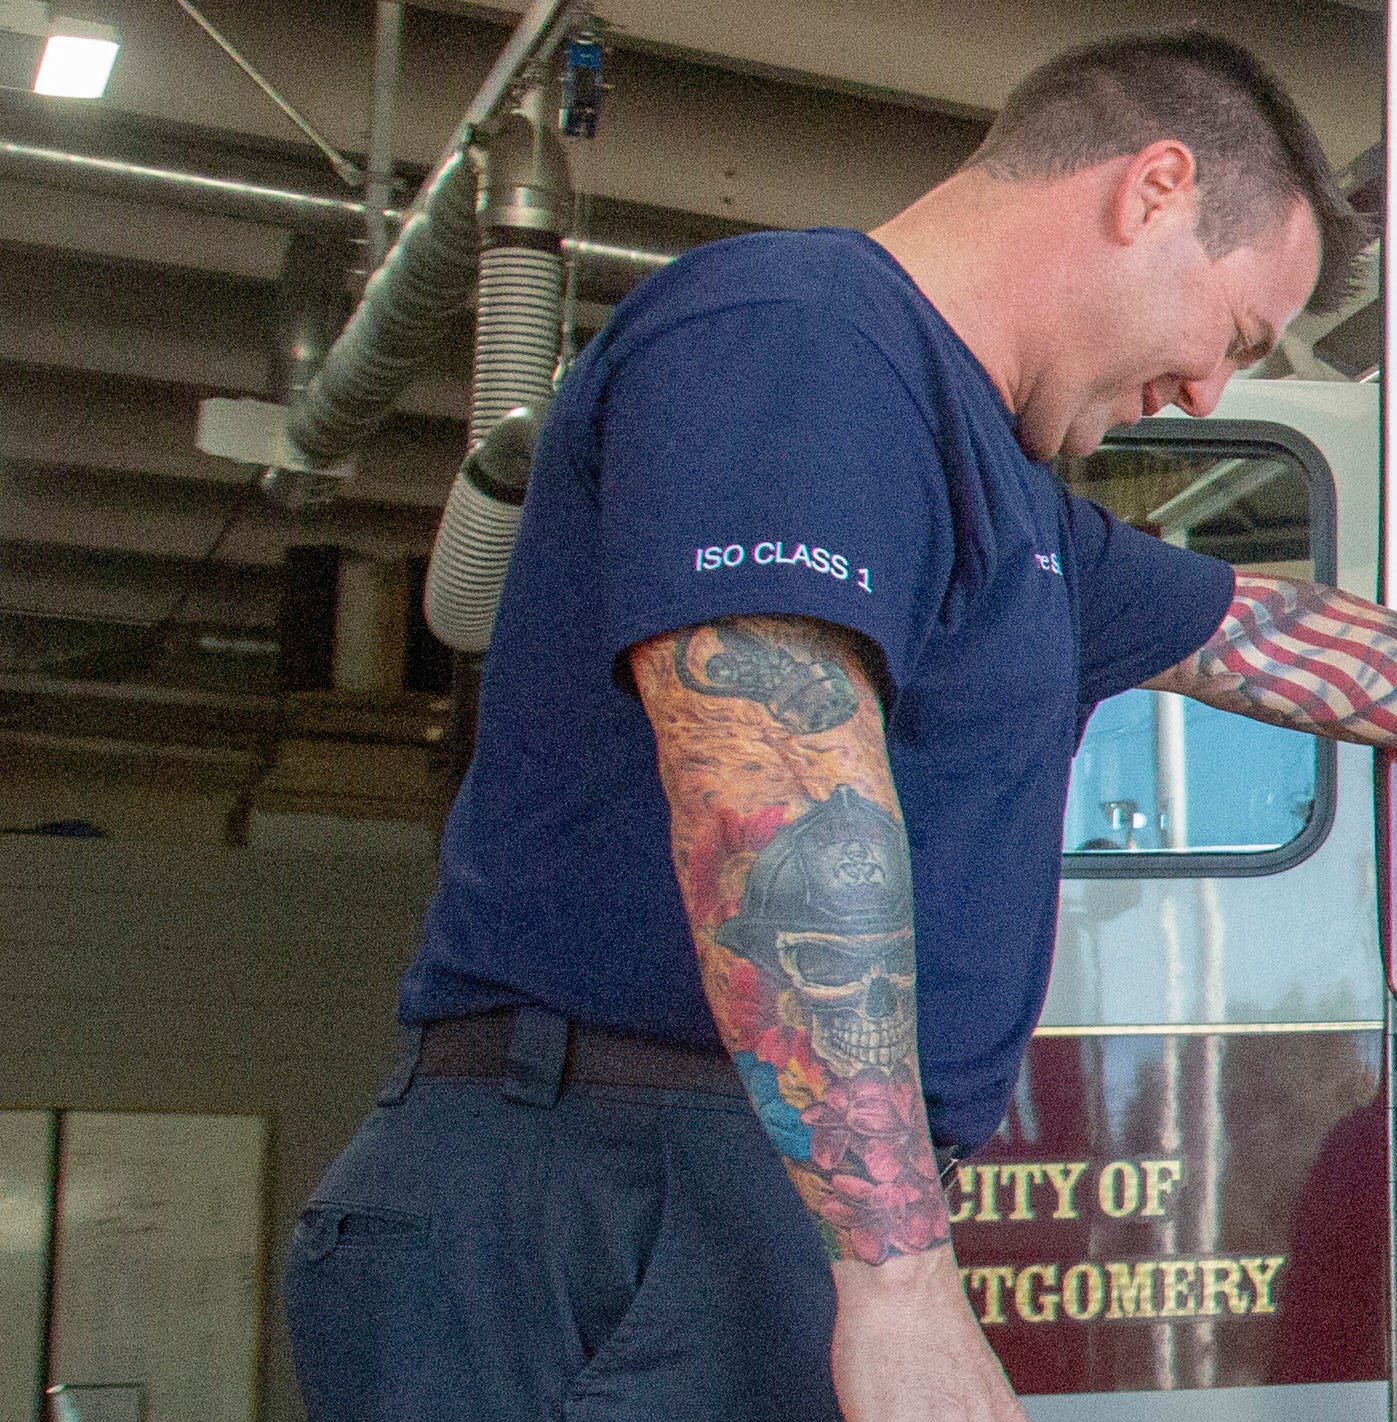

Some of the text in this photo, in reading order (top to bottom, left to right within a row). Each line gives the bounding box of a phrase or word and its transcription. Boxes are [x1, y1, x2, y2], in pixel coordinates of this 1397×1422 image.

[694, 541, 872, 593] ISO CLASS 1
[950, 1159, 1182, 1223] CITY OF
[960, 1256, 1285, 1324] TGOMERY
